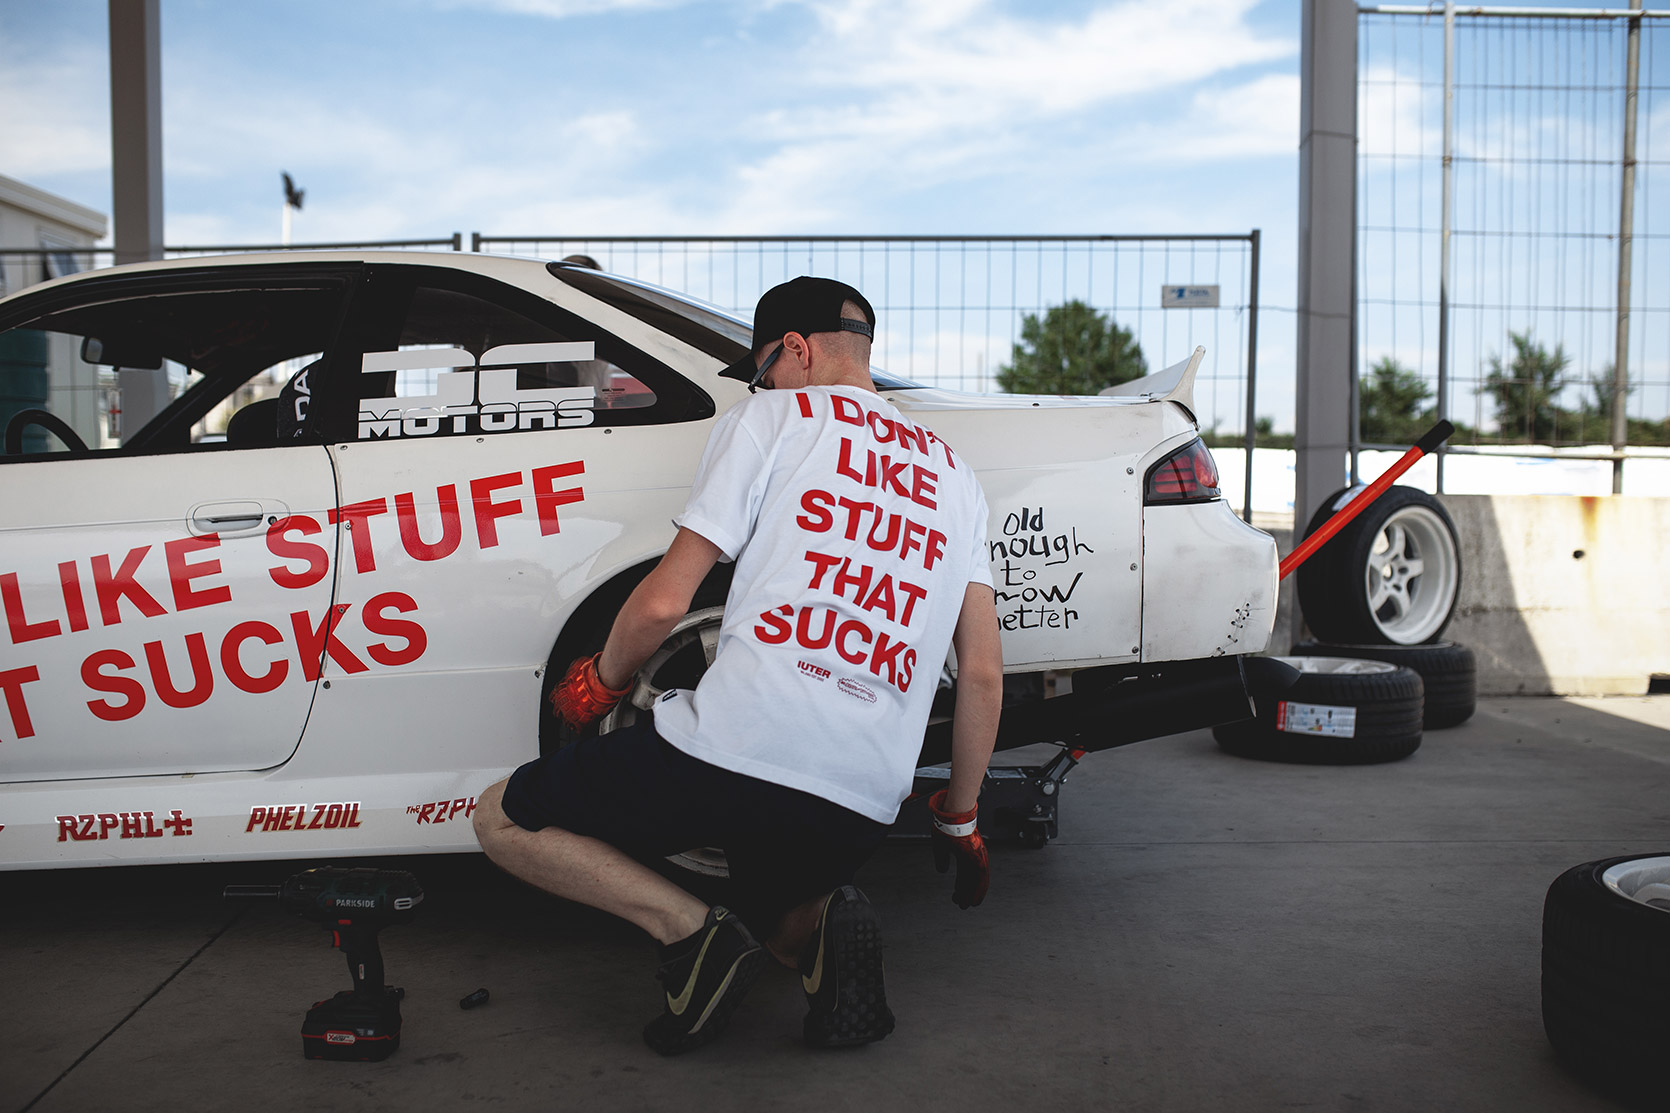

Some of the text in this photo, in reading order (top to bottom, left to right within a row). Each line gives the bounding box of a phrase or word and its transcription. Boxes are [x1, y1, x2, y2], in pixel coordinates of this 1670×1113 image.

[358, 398, 595, 439] MOTORS
[795, 392, 957, 470] I DON'T
[836, 437, 938, 511] LIKE
[0, 460, 587, 645] LIKE STUFF
[796, 489, 947, 571] STUFF
[984, 526, 1094, 567] nough
[804, 550, 928, 628] THAT
[994, 572, 1083, 606] now
[1000, 559, 1036, 586] to
[997, 604, 1078, 631] etter
[80, 591, 428, 722] SUCKS
[754, 604, 917, 693] SUCKS
[244, 801, 363, 833] PHELZOIL
[335, 898, 376, 908] PARKSIDE
